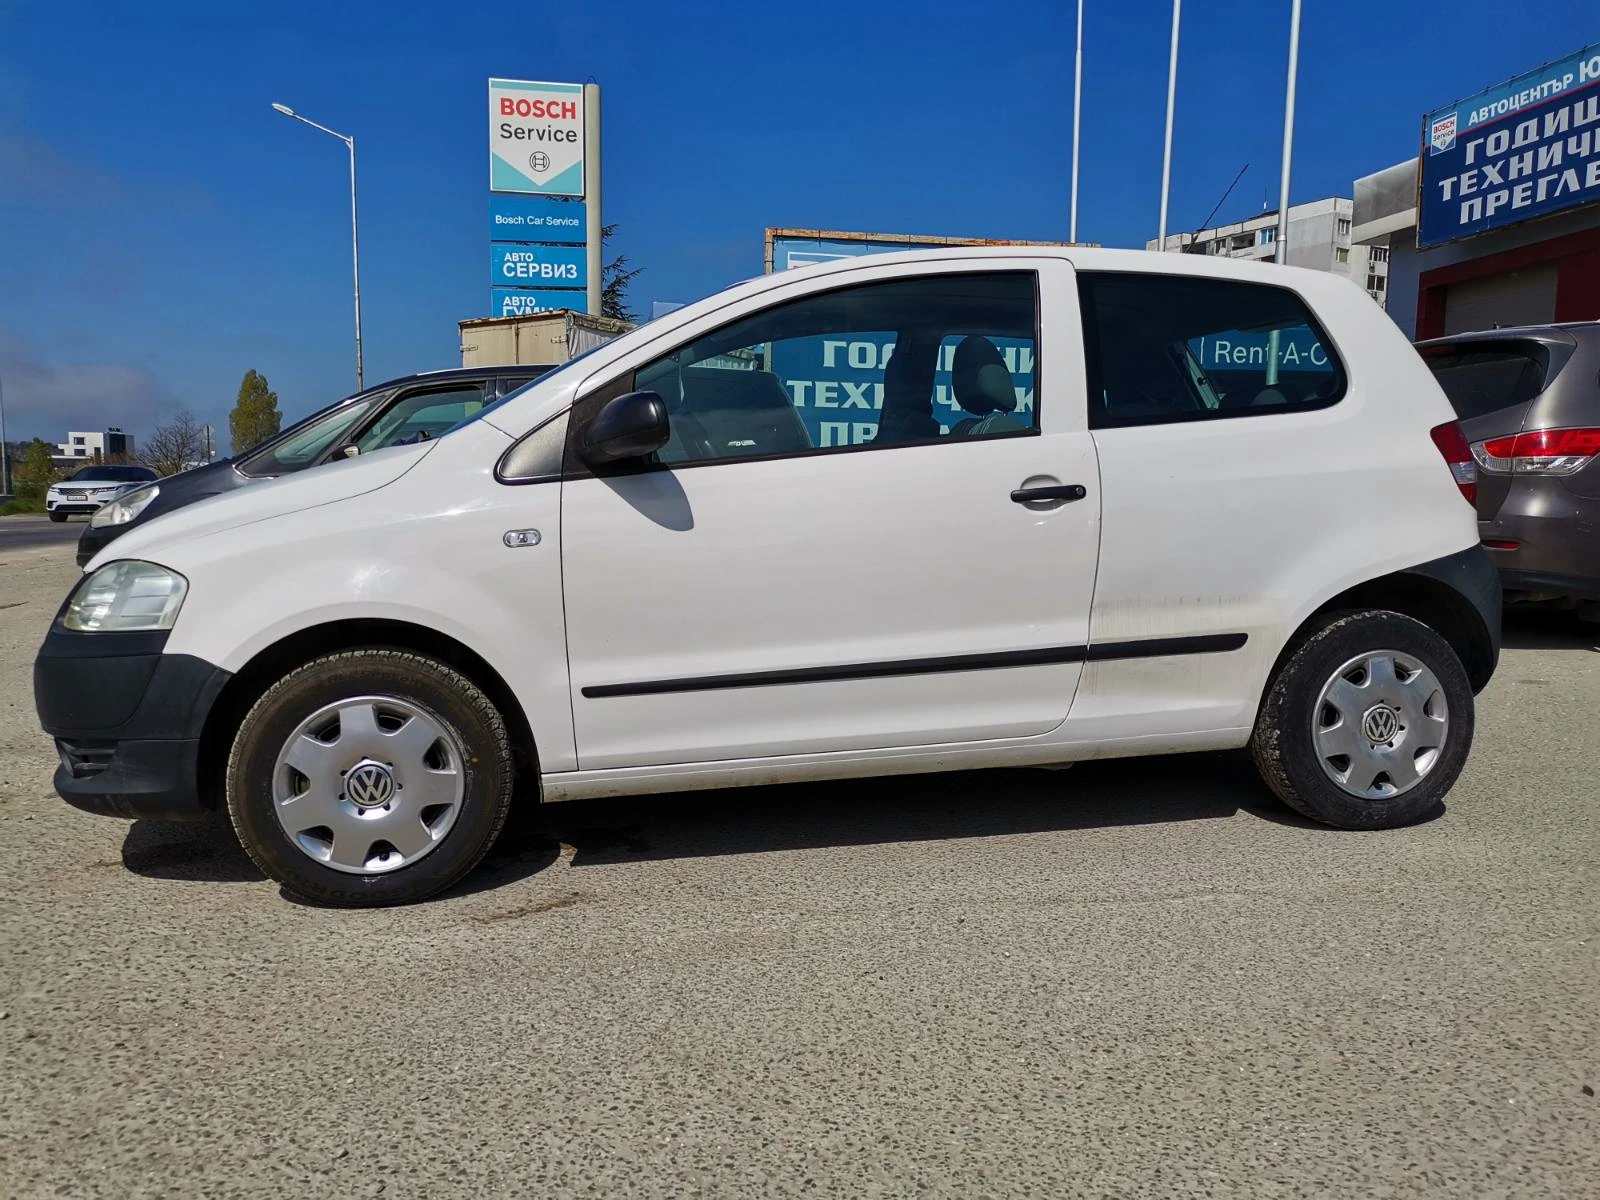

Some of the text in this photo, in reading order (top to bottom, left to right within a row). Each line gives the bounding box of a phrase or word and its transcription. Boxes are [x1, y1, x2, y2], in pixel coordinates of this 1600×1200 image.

[1468, 73, 1574, 126] АВТОЦЕНТЪР
[500, 98, 577, 120] BOSCH
[500, 123, 578, 143] Service
[1433, 118, 1455, 134] BOSCH
[1432, 128, 1455, 142] Service
[1439, 132, 1600, 201] ТЕХНИЧ
[495, 214, 580, 227] Bosch Car Service
[504, 252, 534, 262] АВТО
[503, 262, 578, 279] СЕРВИЗ
[503, 296, 536, 306] АВТО
